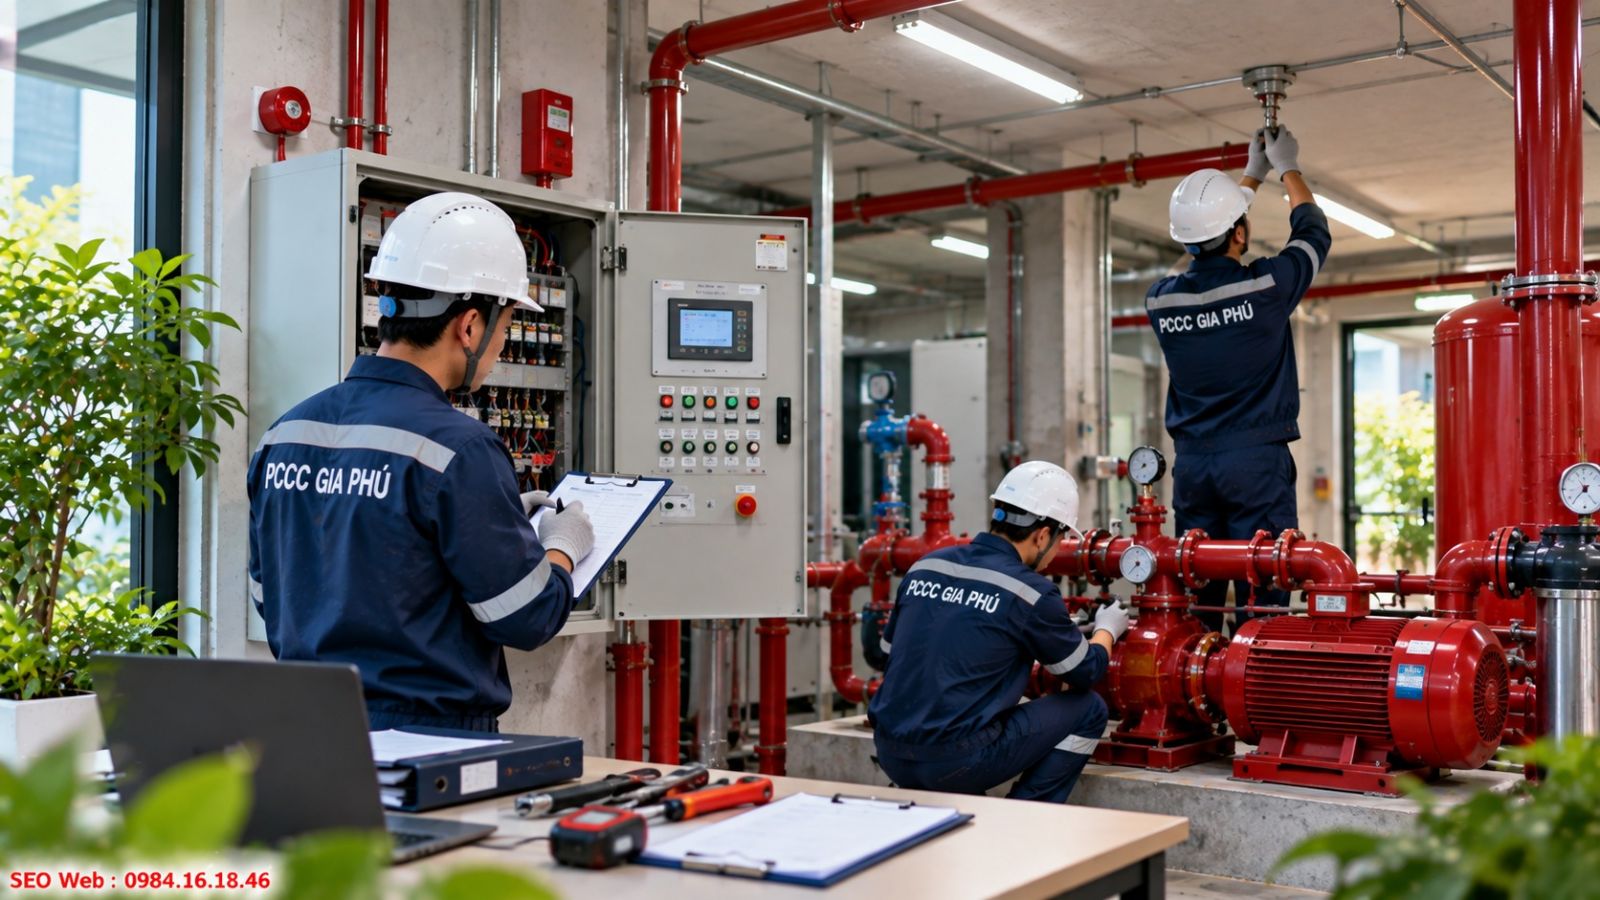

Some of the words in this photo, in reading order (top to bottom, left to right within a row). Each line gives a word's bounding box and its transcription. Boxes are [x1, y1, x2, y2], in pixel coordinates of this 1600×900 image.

[1159, 315, 1194, 334] PCCC
[1196, 311, 1221, 329] GIA
[1222, 300, 1254, 324] PHÚ
[265, 462, 311, 491] PCCC
[315, 467, 343, 495] GIA
[347, 464, 391, 499] PHÚ
[906, 579, 941, 599] PCCC
[941, 586, 965, 604] GIA
[965, 590, 1000, 613] PHÚ
